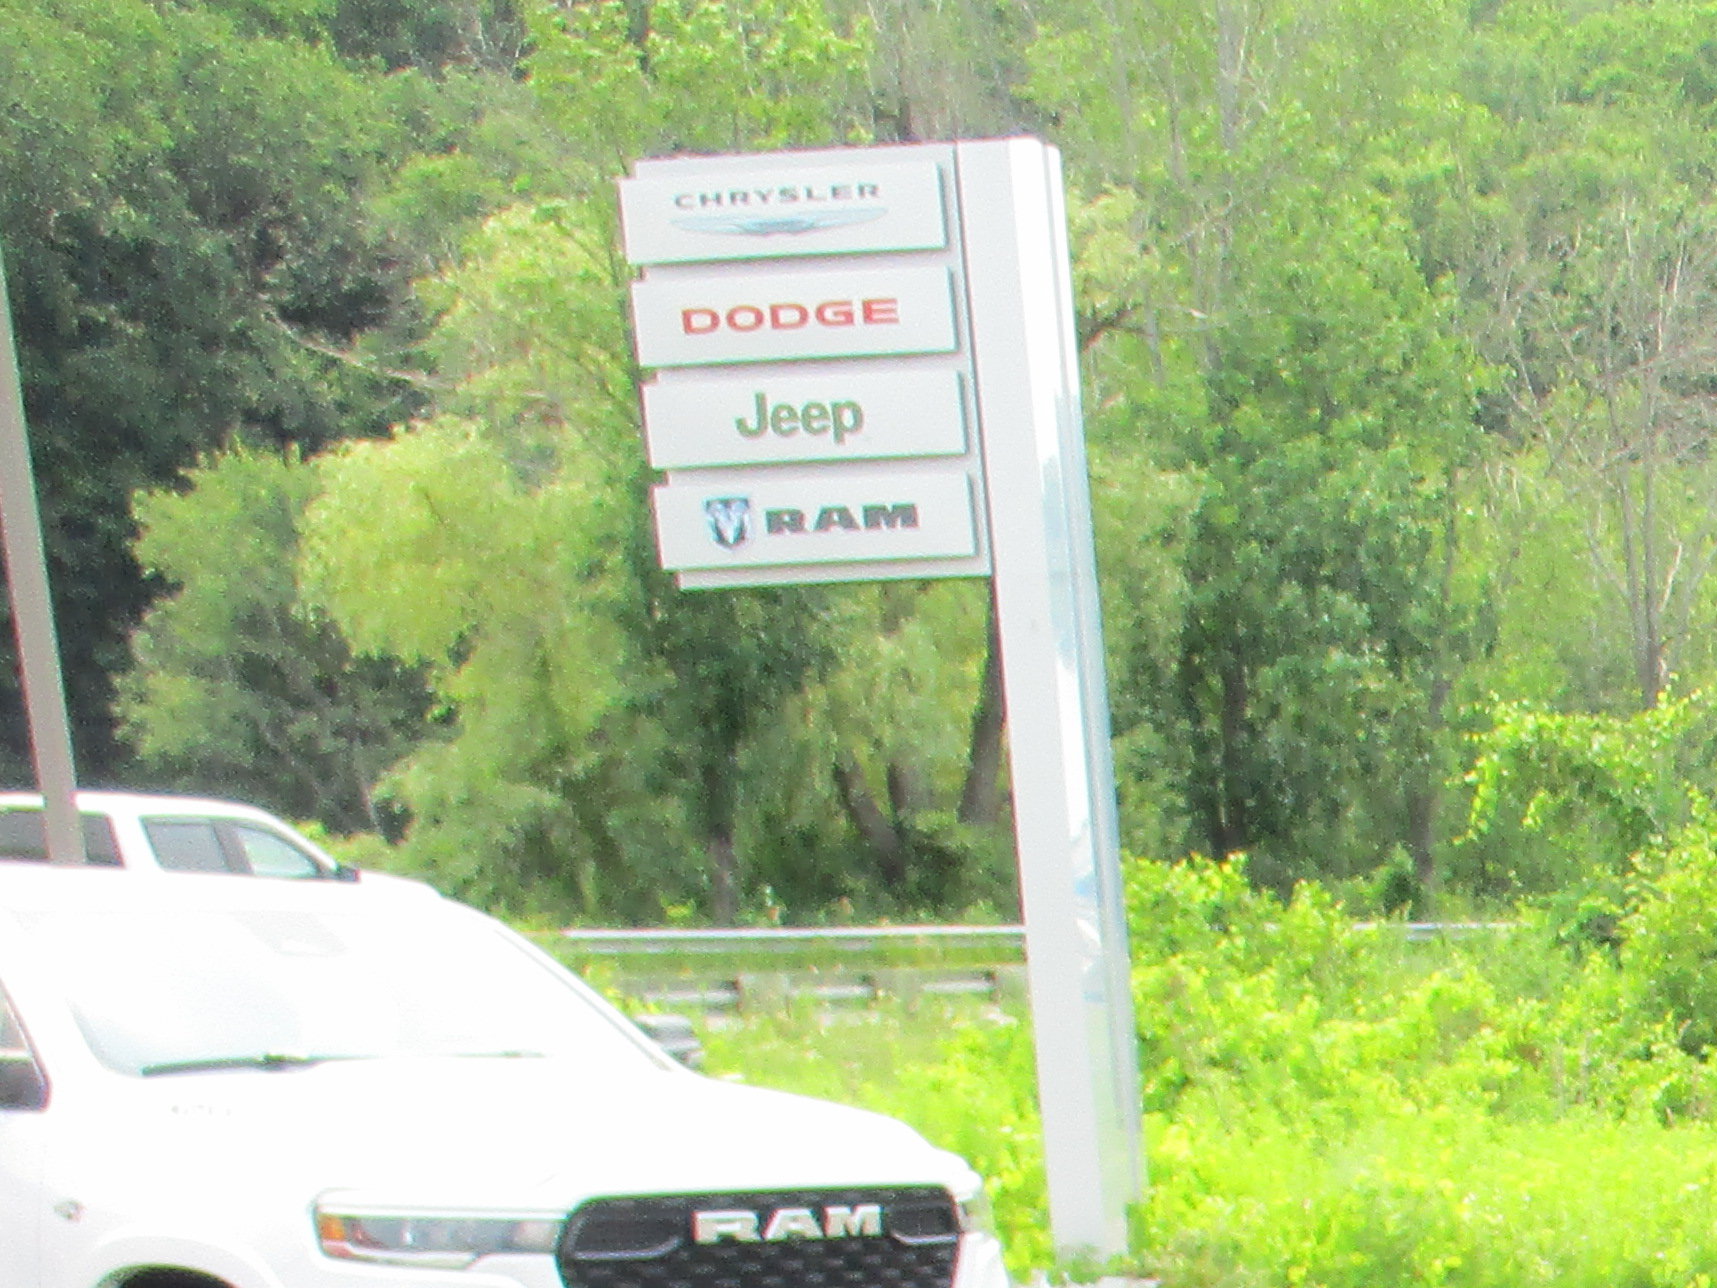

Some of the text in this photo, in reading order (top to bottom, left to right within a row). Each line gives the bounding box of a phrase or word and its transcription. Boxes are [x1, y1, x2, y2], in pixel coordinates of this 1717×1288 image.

[674, 183, 880, 208] CHRYSLER
[681, 298, 899, 335] DODGE
[735, 391, 864, 445] Jeep
[765, 503, 919, 534] RAM
[691, 1204, 882, 1245] RAM
